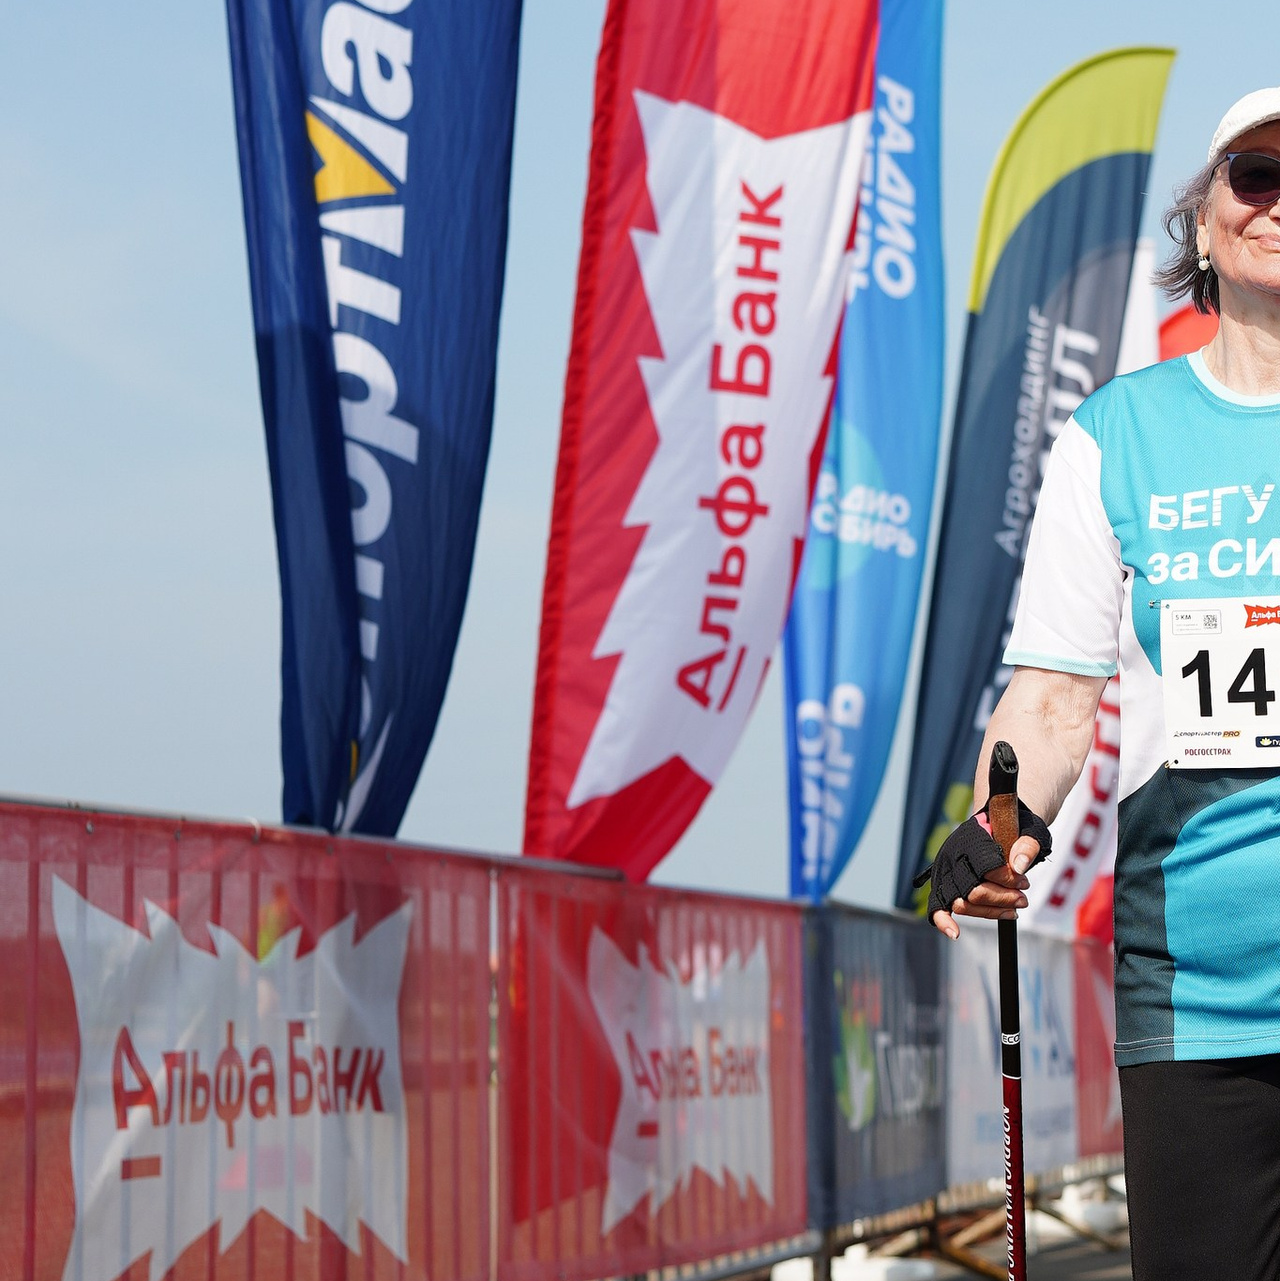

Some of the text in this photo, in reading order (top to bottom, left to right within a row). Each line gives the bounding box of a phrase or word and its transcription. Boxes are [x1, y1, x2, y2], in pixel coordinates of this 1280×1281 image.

[873, 74, 918, 300] РАДИО
[674, 179, 786, 713] Альфа Банк
[1148, 483, 1276, 531] БЕГУ
[1147, 551, 1199, 584] за
[1251, 610, 1276, 620] Альфа
[1184, 748, 1232, 756] РОСГОССТРАХ
[111, 1020, 387, 1149] Альфа Банк
